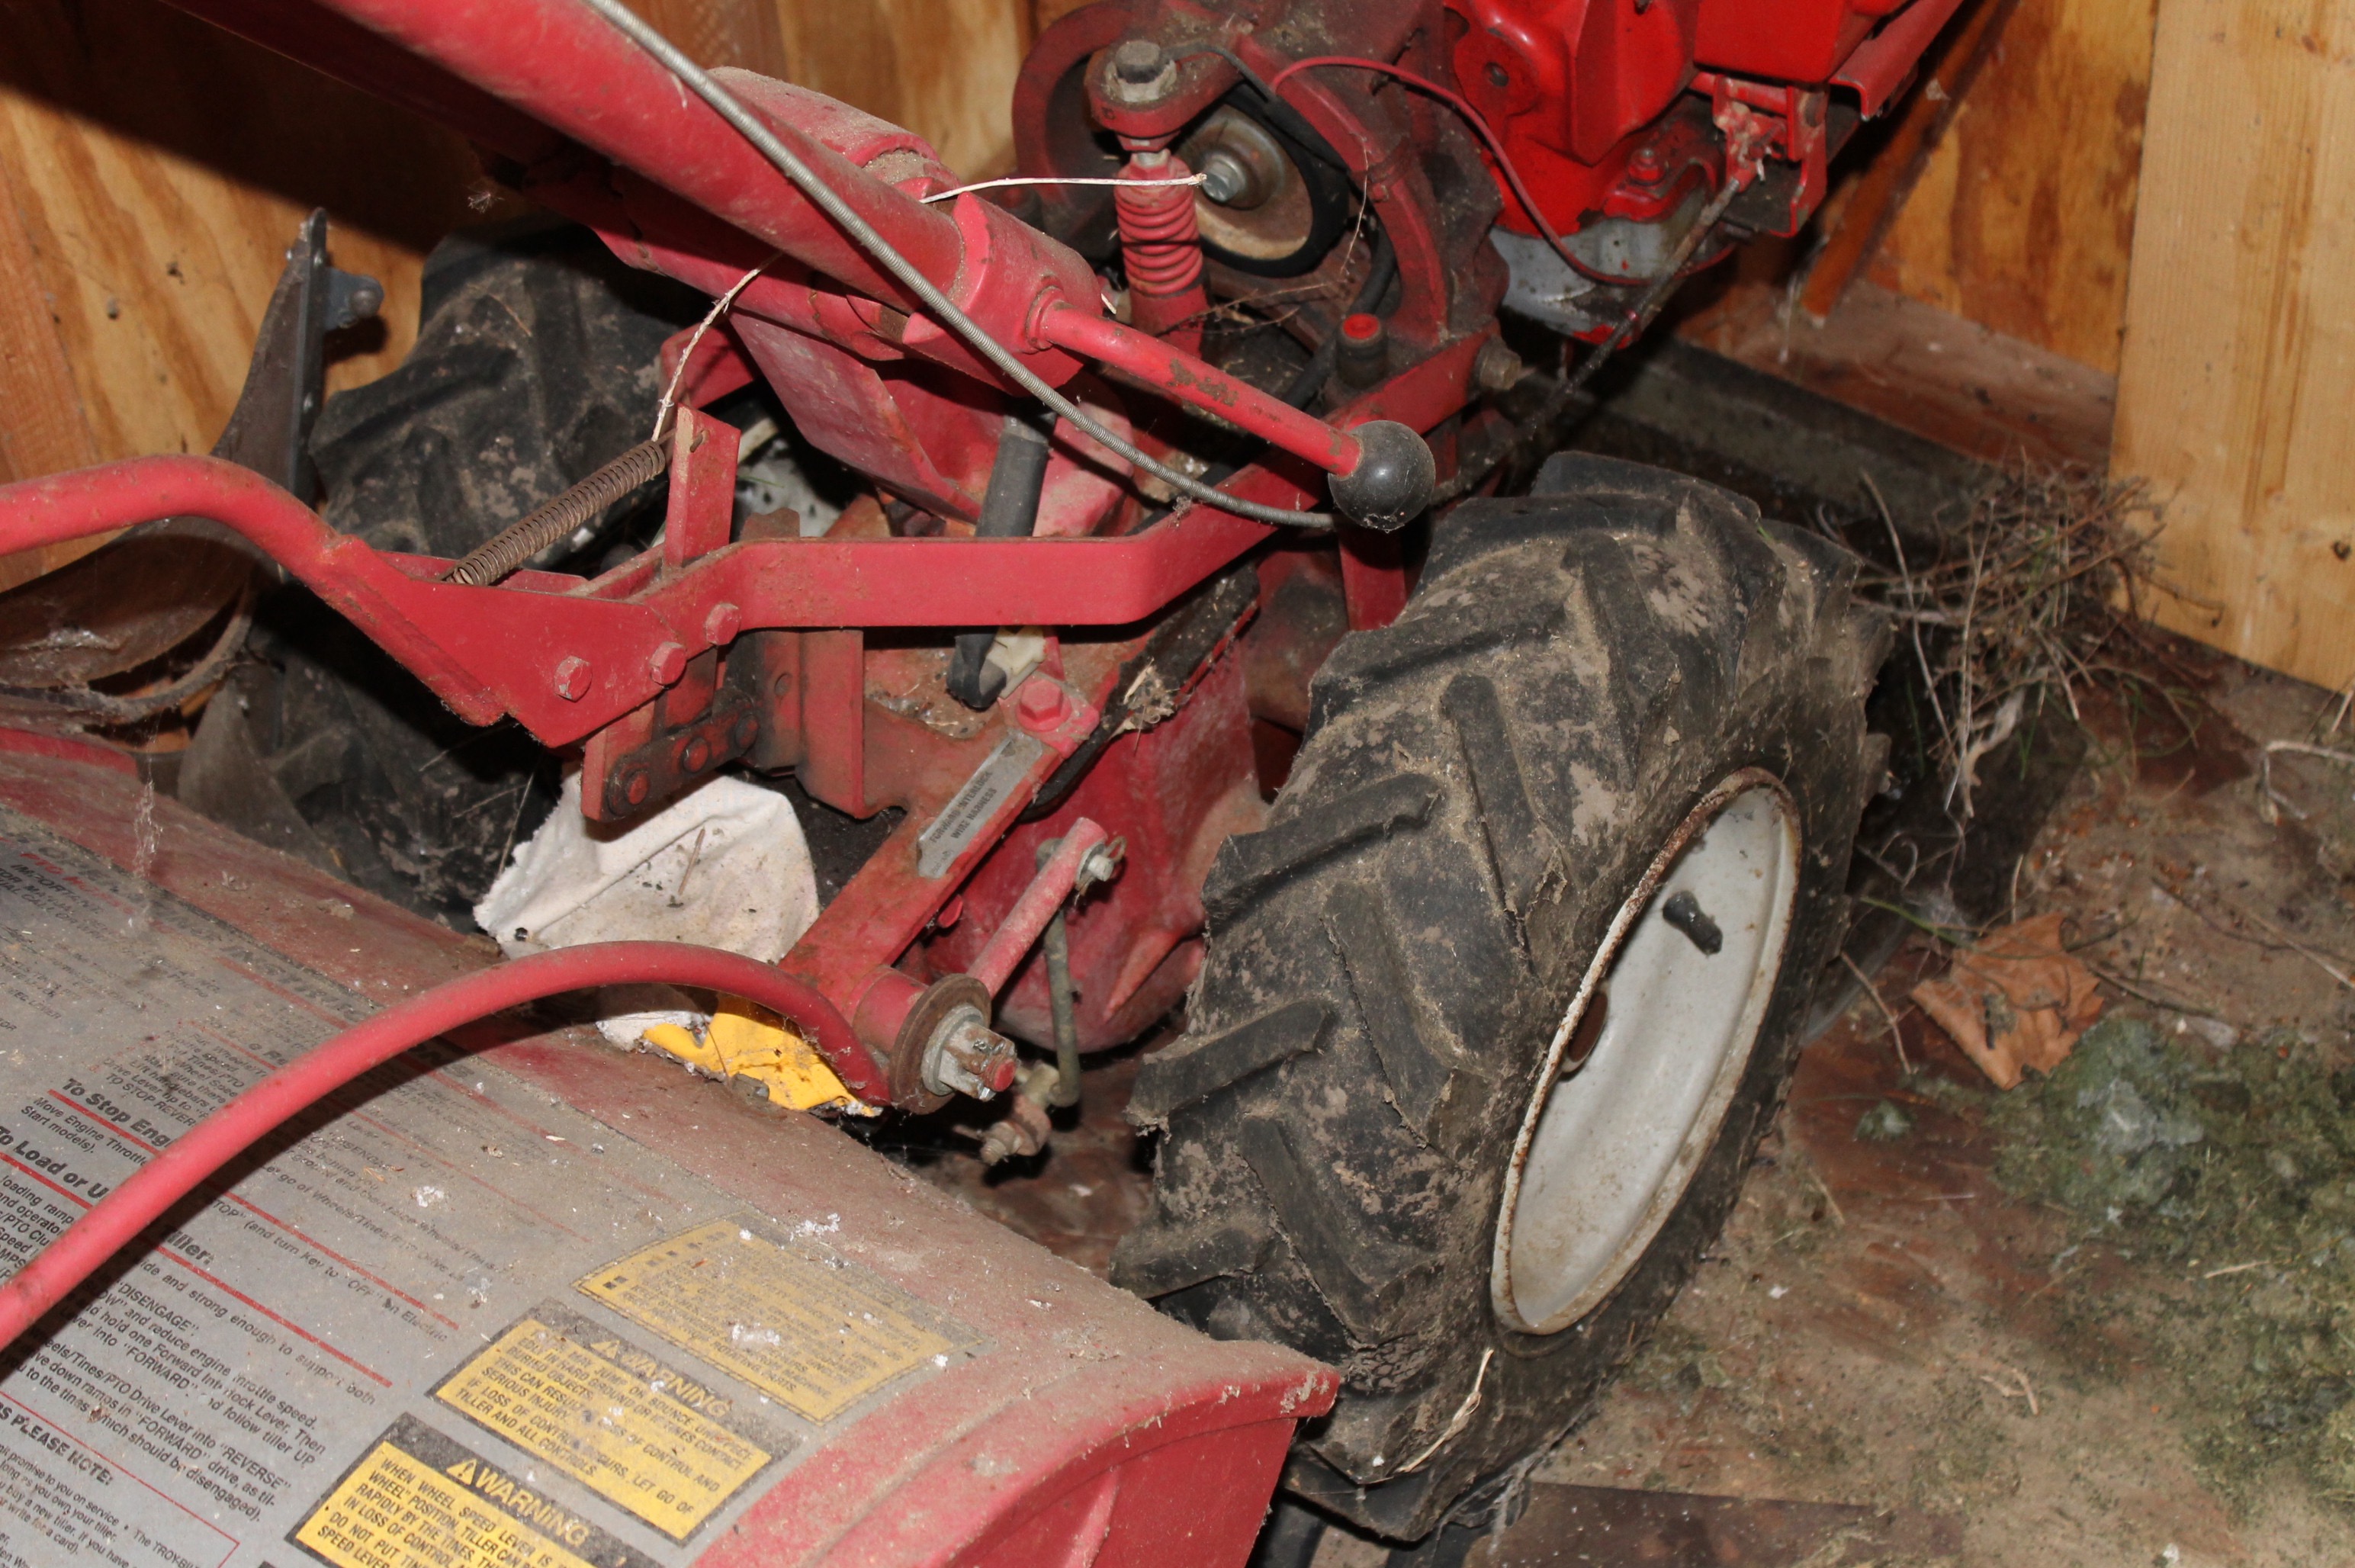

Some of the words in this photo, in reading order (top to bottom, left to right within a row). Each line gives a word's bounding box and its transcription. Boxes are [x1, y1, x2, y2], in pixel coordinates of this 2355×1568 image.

[950, 820, 970, 839] WIRE
[965, 787, 998, 820] HARNESS
[60, 1078, 88, 1097] To
[82, 1091, 133, 1126] Stop
[101, 1057, 132, 1078] Drive
[130, 1074, 163, 1095] Lever
[177, 1100, 194, 1112] to
[128, 1059, 150, 1074] Lift
[12, 1139, 67, 1176] Load
[60, 1169, 89, 1190] or
[18, 1104, 50, 1126] Start
[46, 1121, 98, 1155] models).
[104, 1072, 124, 1086] TO
[121, 1081, 156, 1104] STOP
[277, 1173, 297, 1186] go
[32, 1096, 65, 1118] Move
[62, 1114, 106, 1143] Engine
[242, 1218, 275, 1242] (and
[271, 1236, 300, 1256] turn
[323, 1265, 341, 1280] to
[0, 1175, 44, 1207] loading
[160, 1272, 188, 1293] and
[185, 1287, 230, 1319] strong
[226, 1313, 278, 1348] enough
[276, 1341, 295, 1357] to
[98, 1309, 131, 1335] hold
[127, 1329, 154, 1348] one
[151, 1342, 204, 1379] Forward
[253, 1406, 294, 1435] Lever.
[289, 1427, 330, 1457] Then
[121, 1306, 151, 1328] and
[146, 1321, 193, 1353] reduce
[186, 1346, 233, 1379] engine
[273, 1398, 321, 1431] speed.
[480, 1365, 531, 1398] SERIOUS
[504, 1345, 550, 1374] BURIED
[618, 1348, 732, 1419] WARNING
[47, 1361, 85, 1387] down
[79, 1381, 121, 1411] ramps
[117, 1404, 133, 1418] in
[203, 1457, 249, 1490] drive,
[240, 1480, 264, 1499] as
[89, 1327, 118, 1348] into
[221, 1406, 263, 1435] follow
[259, 1429, 295, 1454] tiller
[290, 1446, 319, 1469] UP
[127, 1388, 165, 1416] Drive
[157, 1407, 195, 1435] Lever
[190, 1428, 219, 1450] into
[454, 1387, 494, 1414] TILLER
[490, 1409, 519, 1429] AND
[515, 1423, 541, 1442] ALL
[492, 1356, 522, 1377] THIS
[518, 1371, 545, 1390] CAN
[641, 1442, 697, 1478] CONTROL
[692, 1473, 721, 1492] AND
[542, 1351, 561, 1365] IN
[556, 1359, 591, 1383] HARD
[585, 1377, 637, 1410] GROUND
[631, 1403, 653, 1419] OR
[660, 1420, 697, 1444] TINES
[692, 1439, 745, 1473] CONTACT
[646, 1396, 695, 1428] BOUNCE
[8, 1412, 72, 1457] PLEASE
[65, 1448, 118, 1486] NOTE:
[23, 1367, 42, 1382] to
[37, 1375, 63, 1395] the
[124, 1431, 172, 1464] should
[181, 1464, 270, 1525] disengaged).
[465, 1377, 482, 1390] IF
[479, 1386, 512, 1408] LOSS
[509, 1403, 531, 1419] OF
[630, 1474, 656, 1492] LET
[654, 1489, 677, 1505] GO
[674, 1500, 696, 1516] OF
[0, 1460, 23, 1481] long
[30, 1481, 55, 1501] you
[69, 1507, 96, 1528] your
[2, 1485, 27, 1504] buy
[23, 1499, 34, 1509] a
[31, 1503, 55, 1521] new
[50, 1515, 81, 1537] tiller.
[84, 1537, 108, 1557] you
[104, 1550, 131, 1568] have
[5, 1451, 48, 1482] promise
[42, 1473, 58, 1486] to
[52, 1481, 76, 1499] you
[71, 1492, 88, 1506] on
[83, 1500, 121, 1527] service
[130, 1529, 155, 1548] The
[5, 1502, 33, 1523] write
[43, 1527, 55, 1537] a
[50, 1531, 84, 1556] card).
[353, 1483, 404, 1518] RAPIDLY
[400, 1509, 421, 1527] BY
[416, 1520, 442, 1541] THE
[439, 1534, 480, 1563] TINES.
[366, 1470, 411, 1502] WHEEL"
[457, 1525, 500, 1556] TILLER
[494, 1547, 522, 1568] CAN
[377, 1457, 416, 1486] WHEN
[415, 1480, 458, 1511] WHEEL
[456, 1505, 498, 1534] SPEED
[496, 1529, 538, 1558] LEVER
[535, 1552, 554, 1568] IS
[471, 1467, 593, 1548] WARNING
[315, 1524, 356, 1554] SPEED
[327, 1511, 351, 1530] DO
[346, 1522, 376, 1545] NOT
[372, 1538, 401, 1560] PUT
[342, 1496, 361, 1512] IN
[355, 1504, 390, 1529] LOSS
[384, 1521, 406, 1539] OF
[400, 1531, 457, 1568] CONTROL
